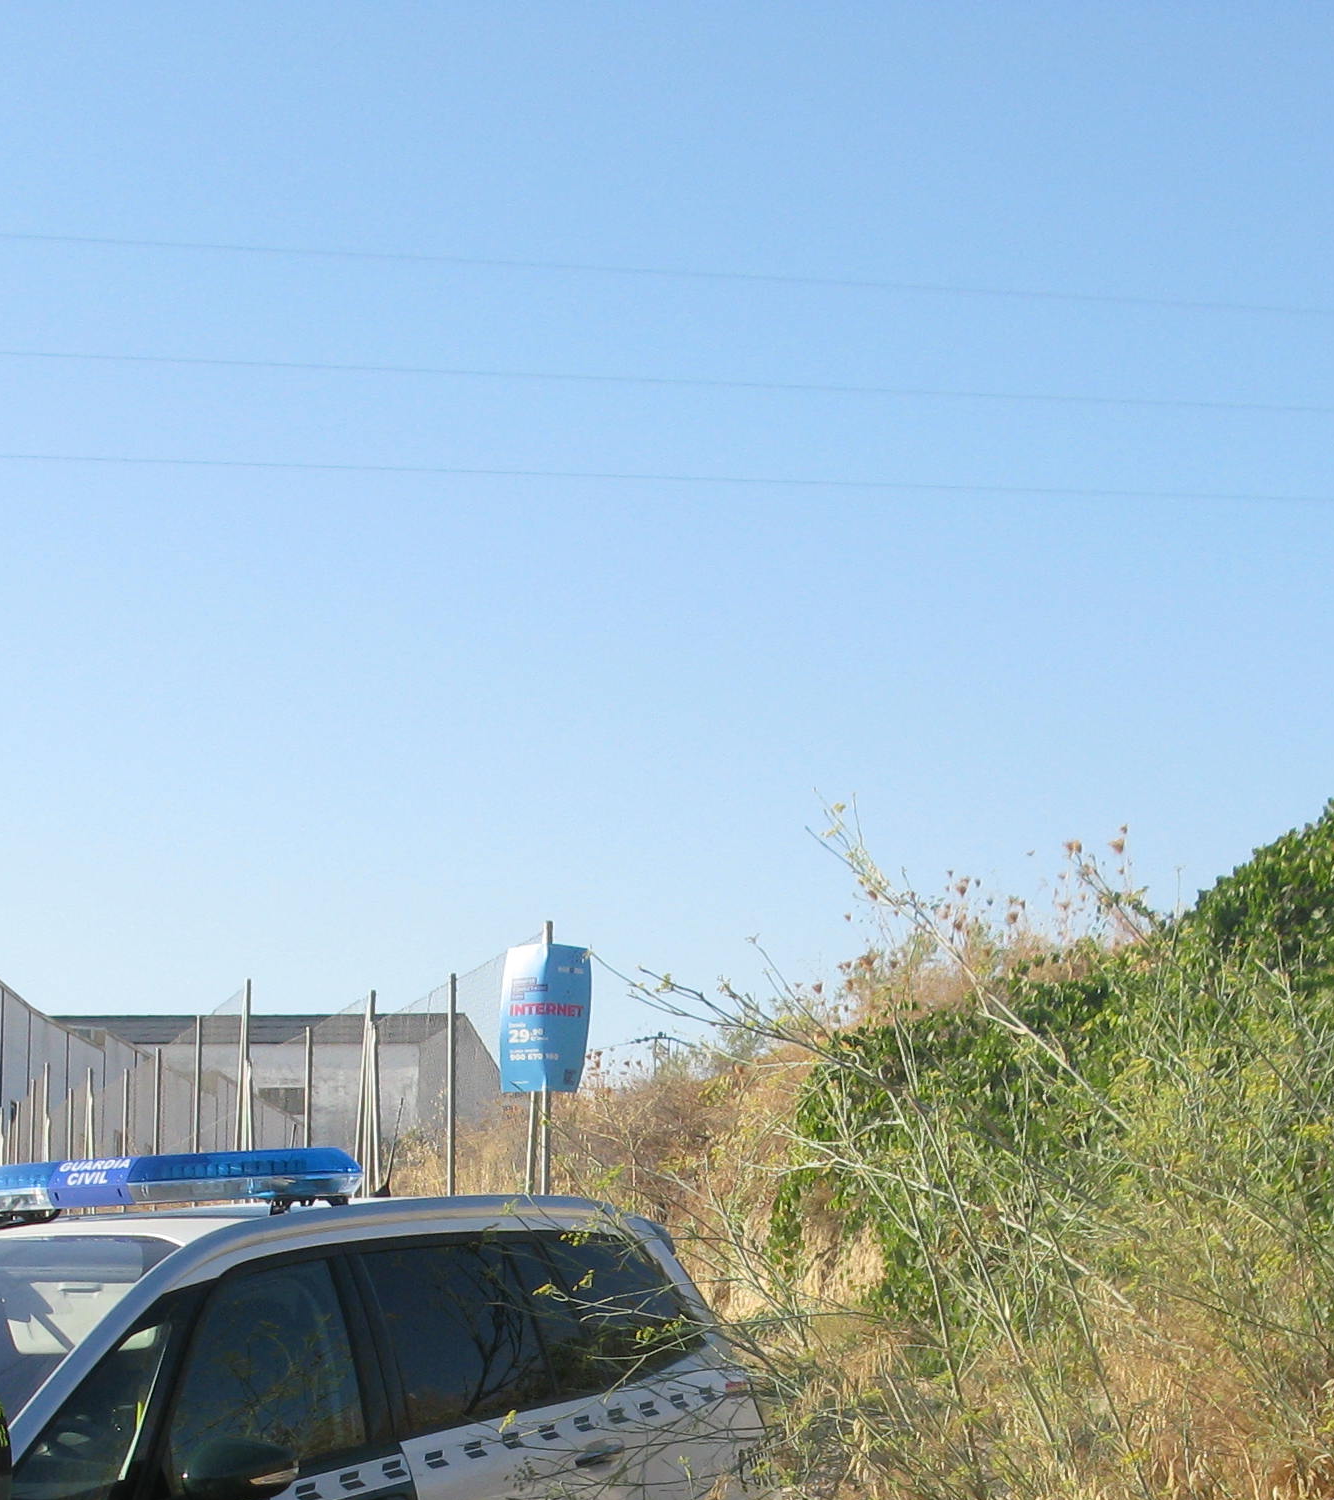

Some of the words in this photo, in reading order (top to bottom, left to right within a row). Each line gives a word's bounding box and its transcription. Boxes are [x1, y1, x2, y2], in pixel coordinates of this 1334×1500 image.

[510, 1002, 584, 1017] INTERNET
[508, 1029, 530, 1043] 29
[59, 1159, 132, 1172] GUARDIA
[67, 1171, 108, 1186] CIVIL
